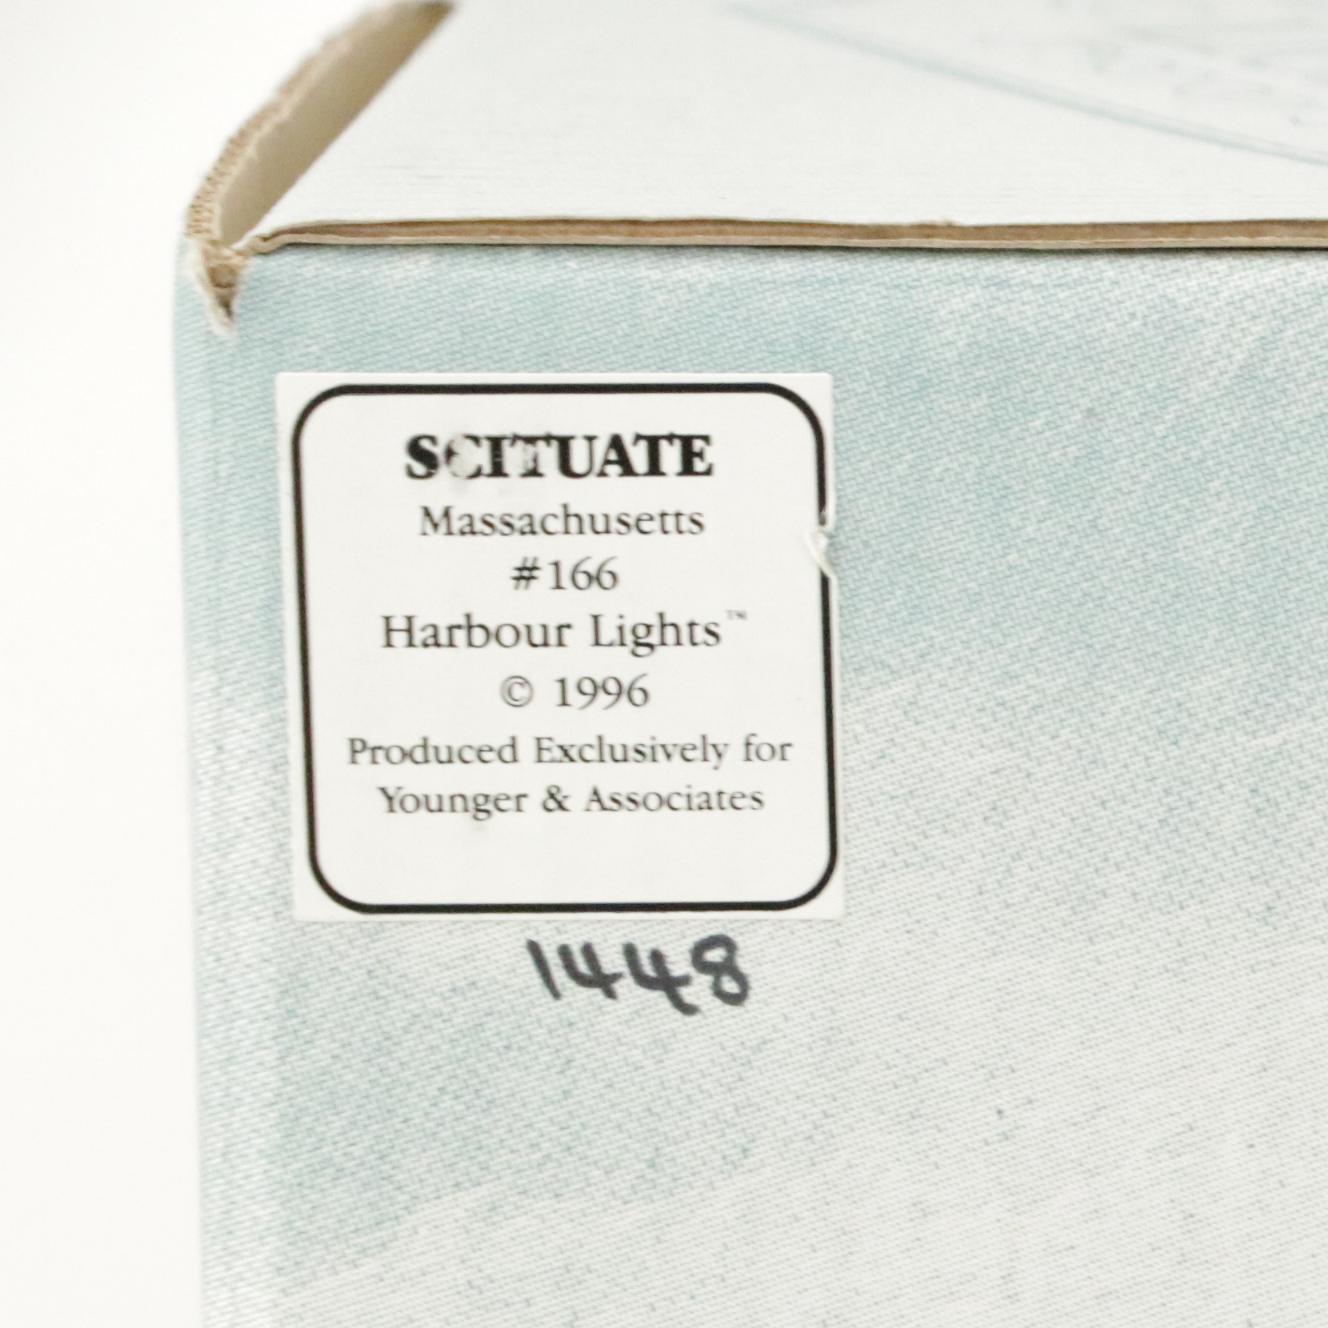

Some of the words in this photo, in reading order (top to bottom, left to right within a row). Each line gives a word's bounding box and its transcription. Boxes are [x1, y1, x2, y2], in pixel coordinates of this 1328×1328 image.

[420, 503, 705, 537] Massachusetts
[511, 556, 619, 591] #166
[382, 612, 573, 649] Harbour
[503, 675, 533, 708] ©
[556, 673, 650, 709] 1996
[348, 735, 519, 765] Produced
[535, 734, 728, 770] Exclusively
[743, 733, 793, 762] for
[378, 786, 529, 822] Younger
[541, 784, 570, 813] &
[585, 786, 764, 812] Associates
[527, 934, 749, 1016] 1448
